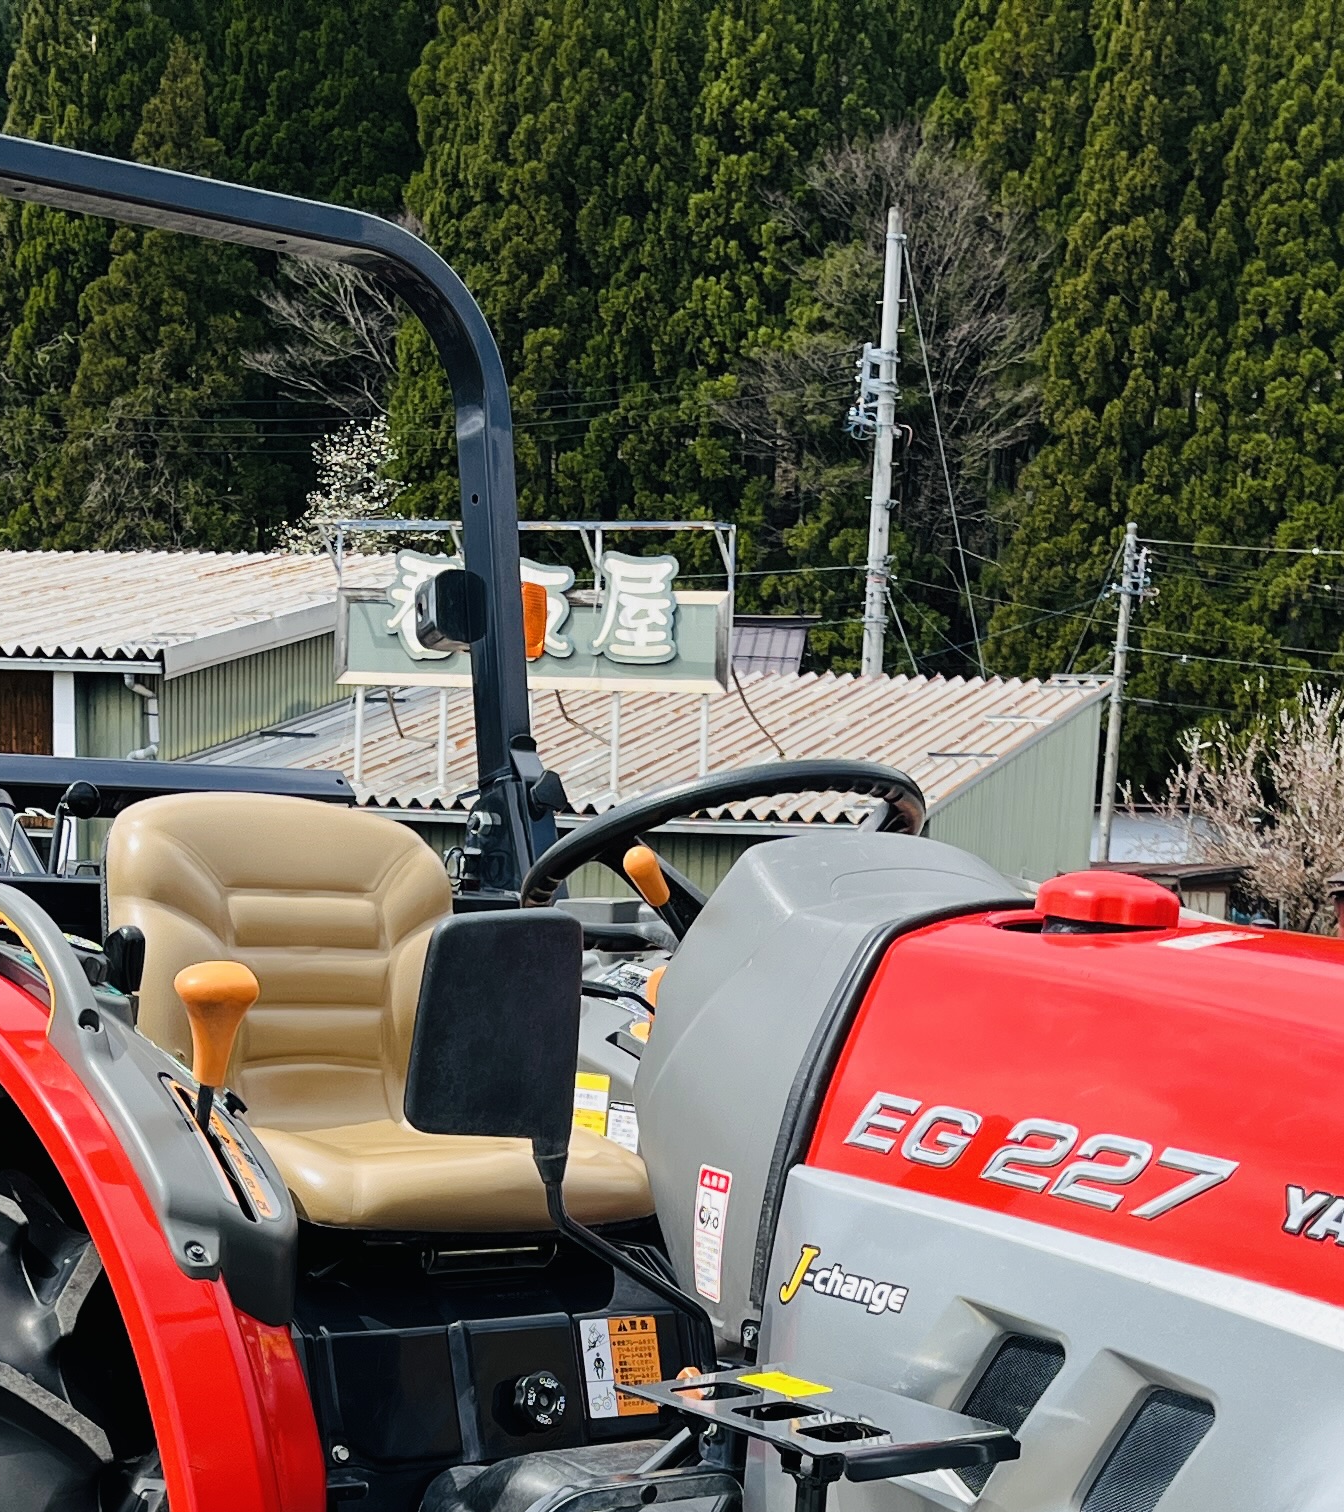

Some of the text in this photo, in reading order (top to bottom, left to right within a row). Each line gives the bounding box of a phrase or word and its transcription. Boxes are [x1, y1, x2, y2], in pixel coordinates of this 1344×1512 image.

[843, 1091, 1240, 1221] EG 227
[778, 1243, 910, 1316] J-change
